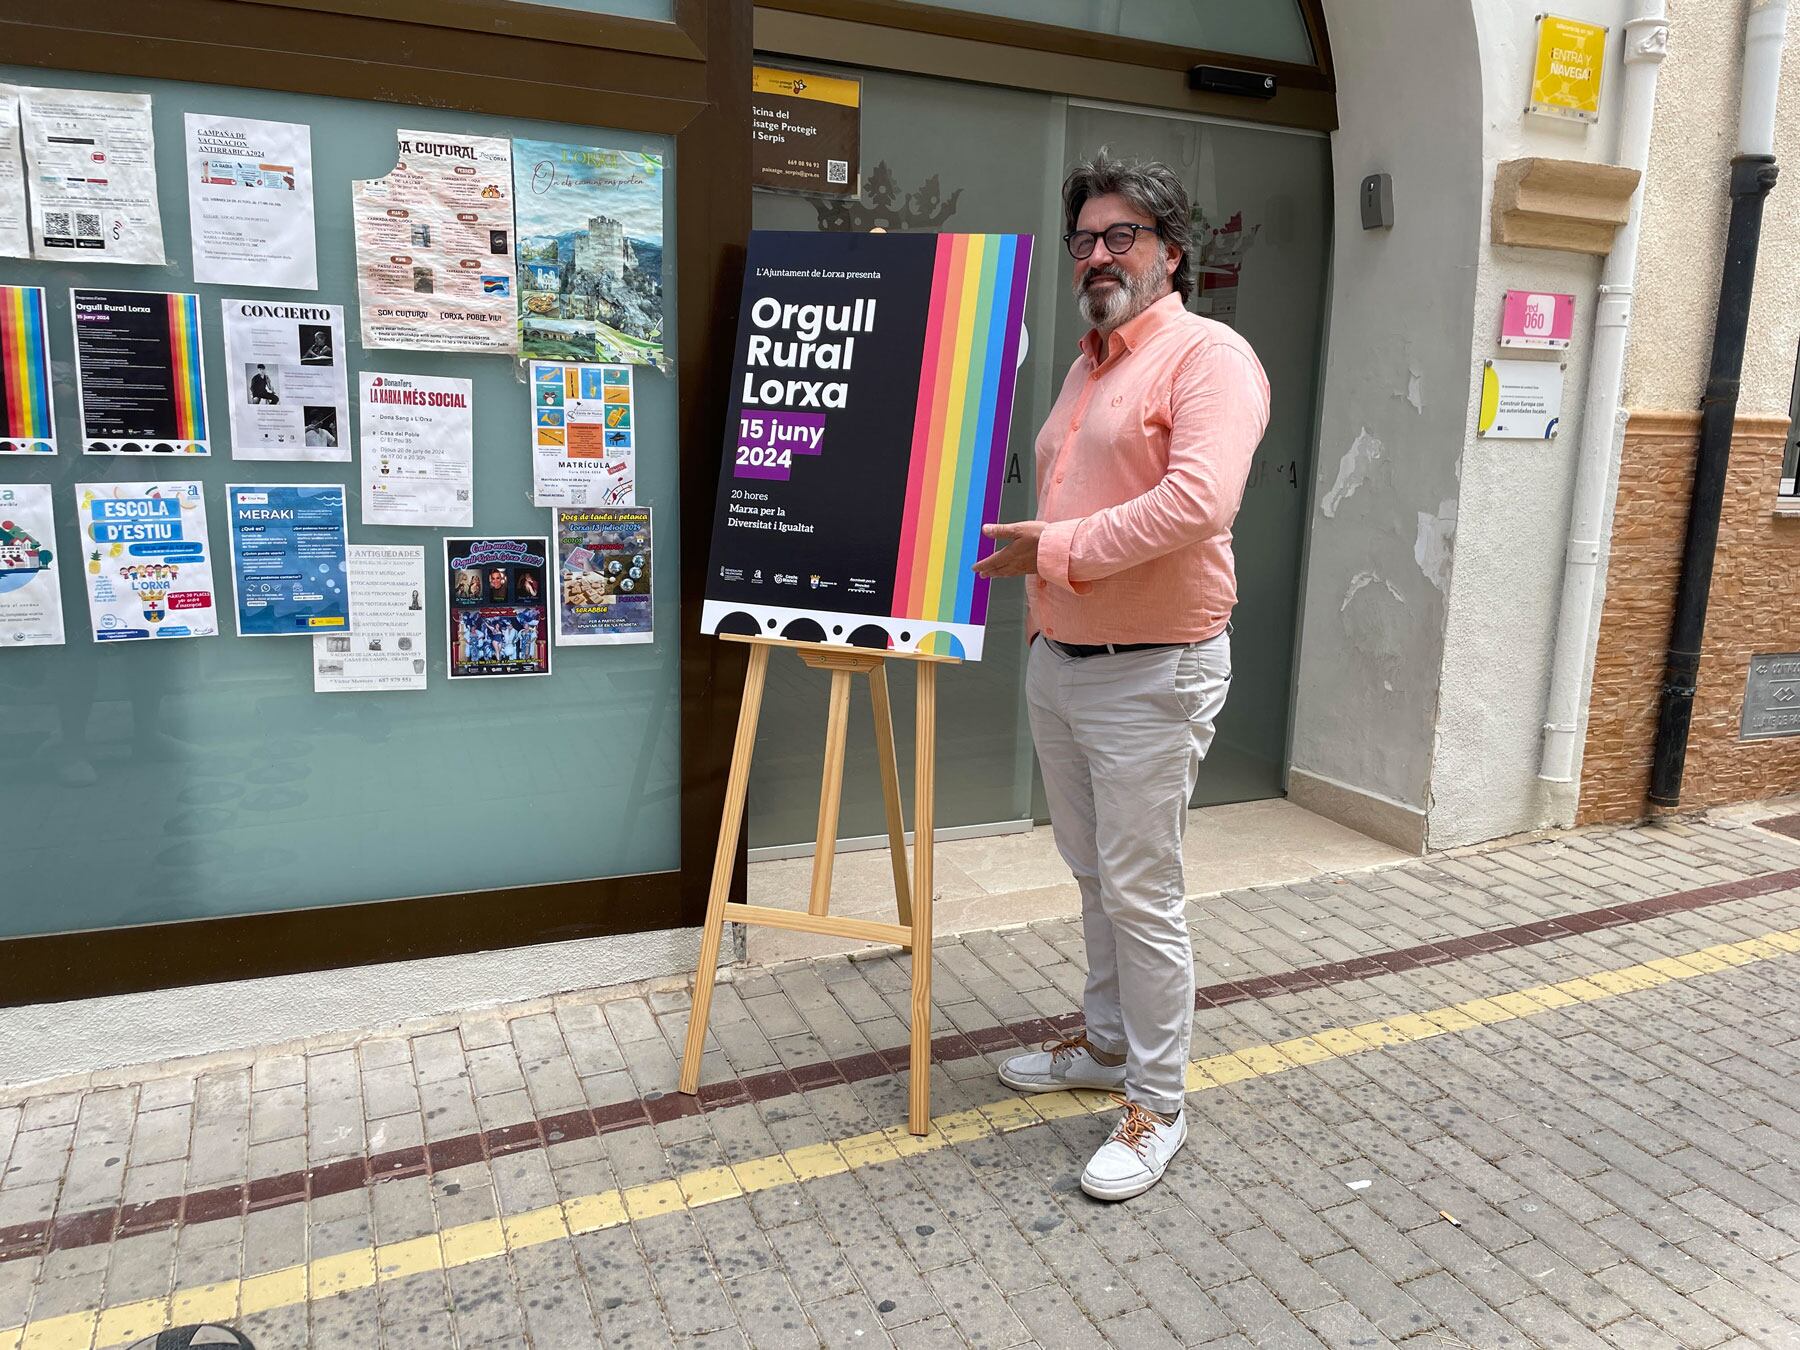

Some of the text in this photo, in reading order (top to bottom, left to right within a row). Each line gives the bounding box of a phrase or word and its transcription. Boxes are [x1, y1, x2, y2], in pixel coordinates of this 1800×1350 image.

[1551, 48, 1592, 65] ¡ENTRA Y
[1550, 62, 1591, 80] NAVEGA!
[776, 110, 789, 120] del
[781, 122, 817, 136] Protegit
[758, 132, 785, 143] Serpis
[416, 142, 478, 160] CULTURAL
[532, 161, 560, 195] On
[562, 176, 572, 187] els
[617, 173, 644, 191] porten
[756, 268, 810, 277] L'Ajuntament
[846, 271, 881, 280] presenta
[76, 304, 102, 312] Orgull
[241, 304, 330, 320] CONCIERTO
[1526, 304, 1538, 313] red
[751, 297, 876, 341] Orgull
[1524, 312, 1545, 329] 060
[747, 335, 854, 370] Rural
[370, 388, 467, 408] LA XARXA MÉS SOCIAL
[742, 372, 848, 408] Lorxa
[740, 419, 825, 449] 15 juny
[736, 446, 792, 468] 2024
[731, 490, 768, 500] 20 hores
[105, 501, 169, 517] ESCOLA
[240, 509, 294, 519] MERAKI
[729, 504, 785, 516] Marxa per la
[107, 523, 172, 540] D'ESTIU
[728, 518, 814, 533] Diversitat i Igualtat
[132, 581, 170, 590] L'ORXA
